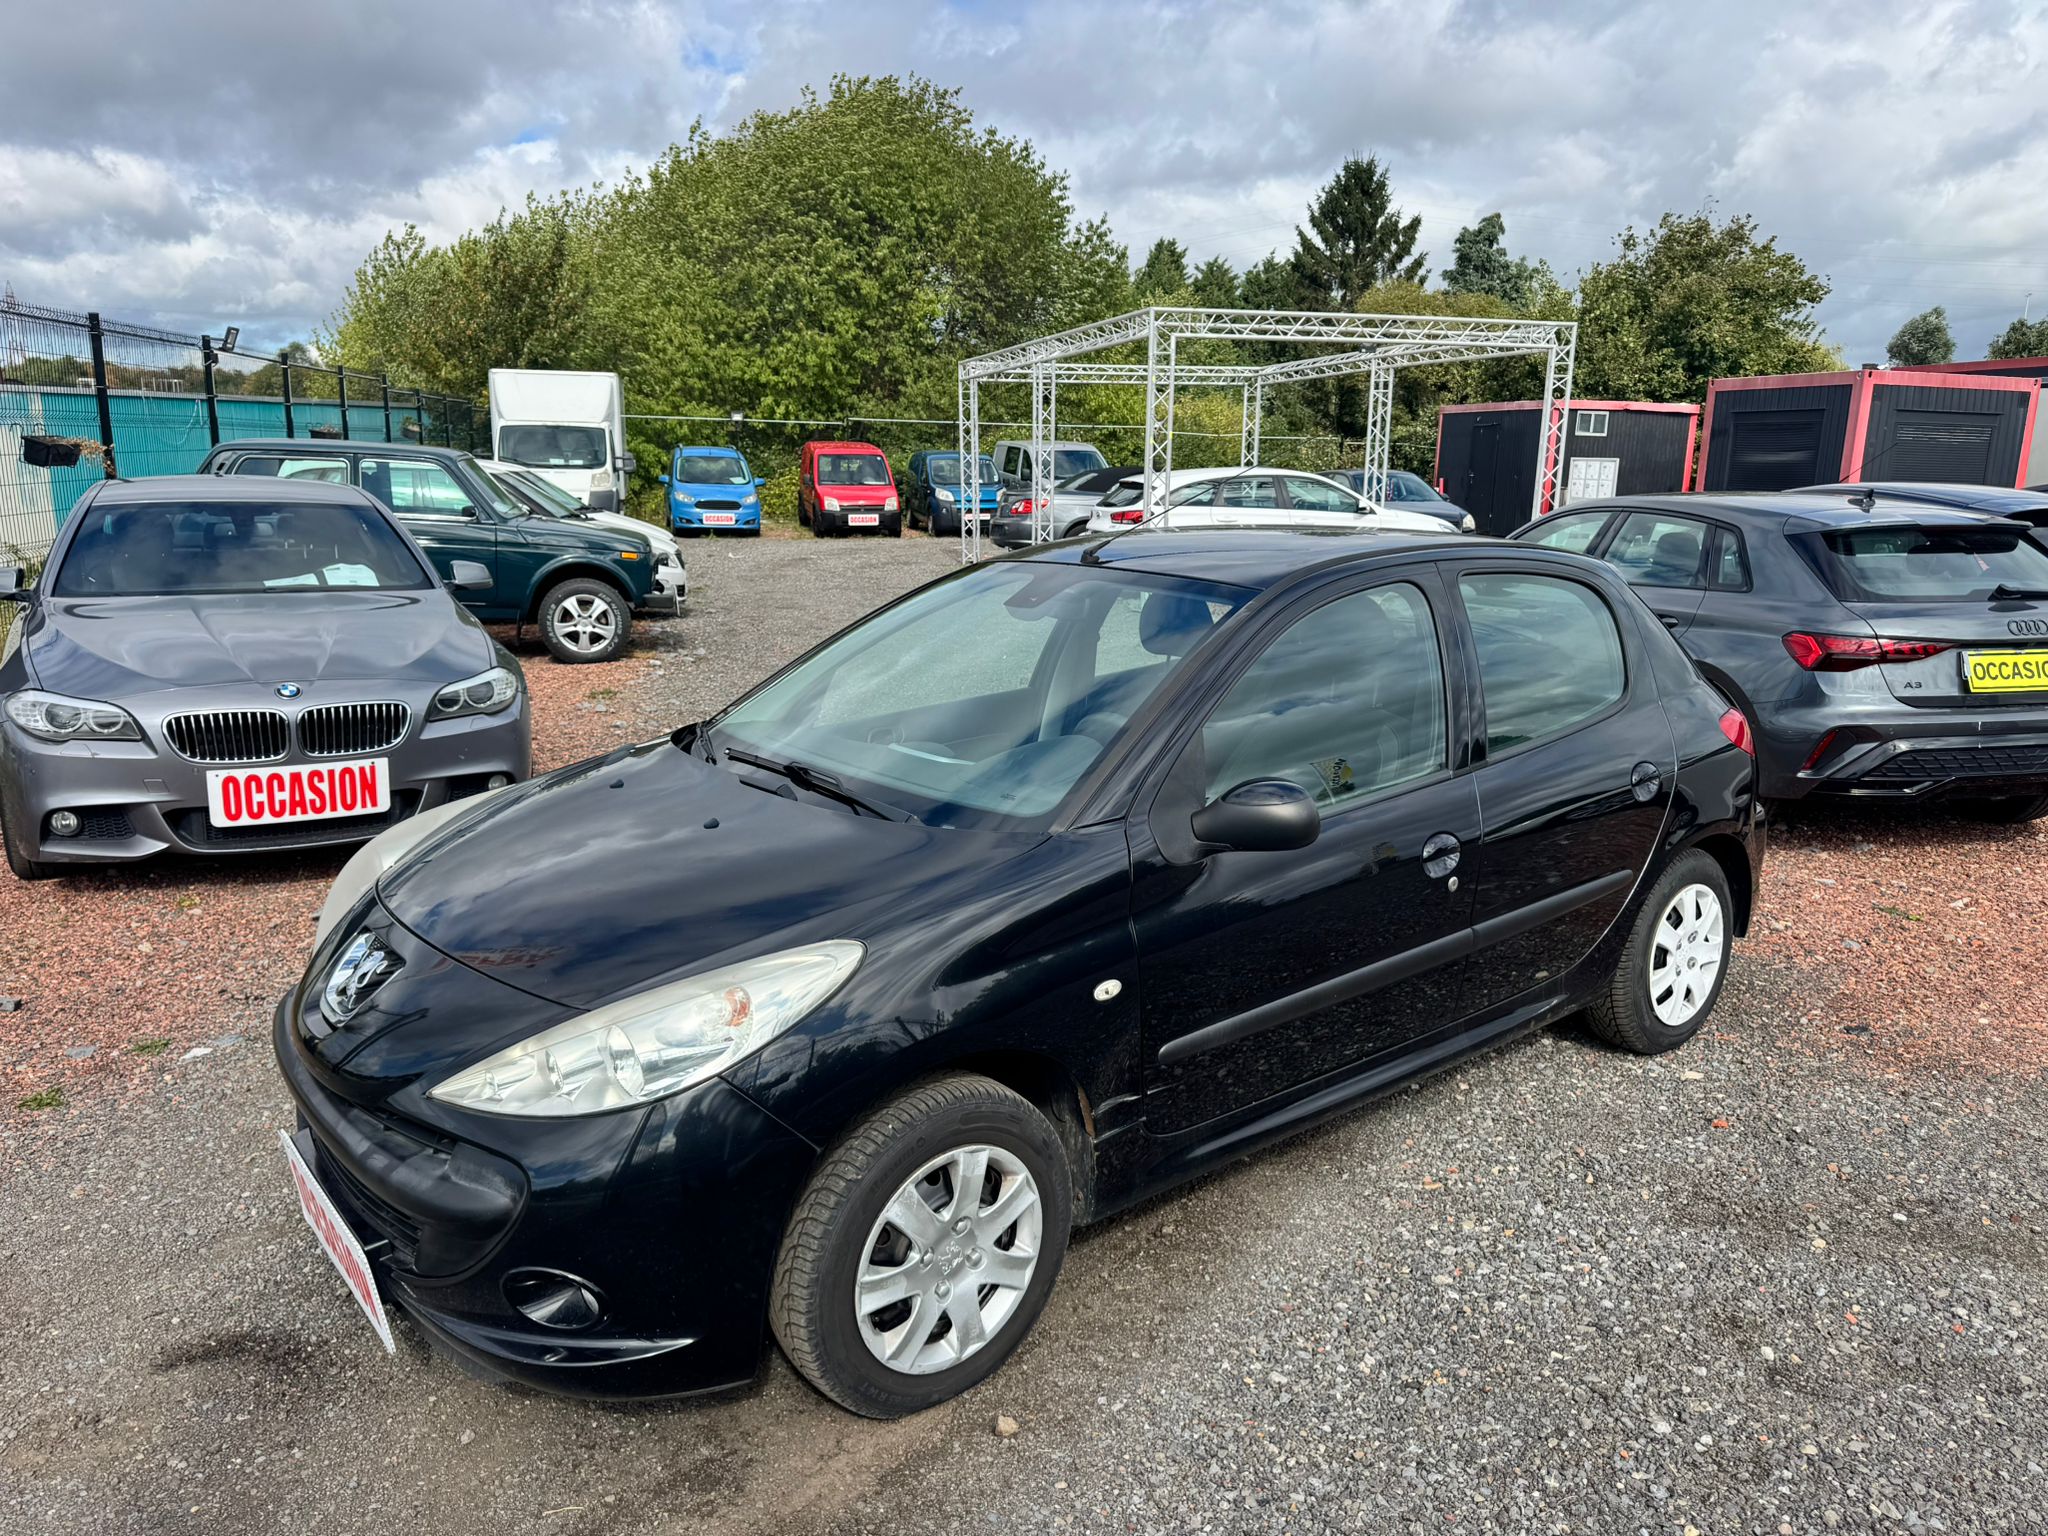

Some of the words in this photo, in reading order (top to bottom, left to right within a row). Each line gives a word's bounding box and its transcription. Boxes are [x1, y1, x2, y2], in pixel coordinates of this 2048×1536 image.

[704, 515, 733, 523] OCCASION
[1903, 681, 1923, 689] A3
[221, 764, 378, 822] OCCASION
